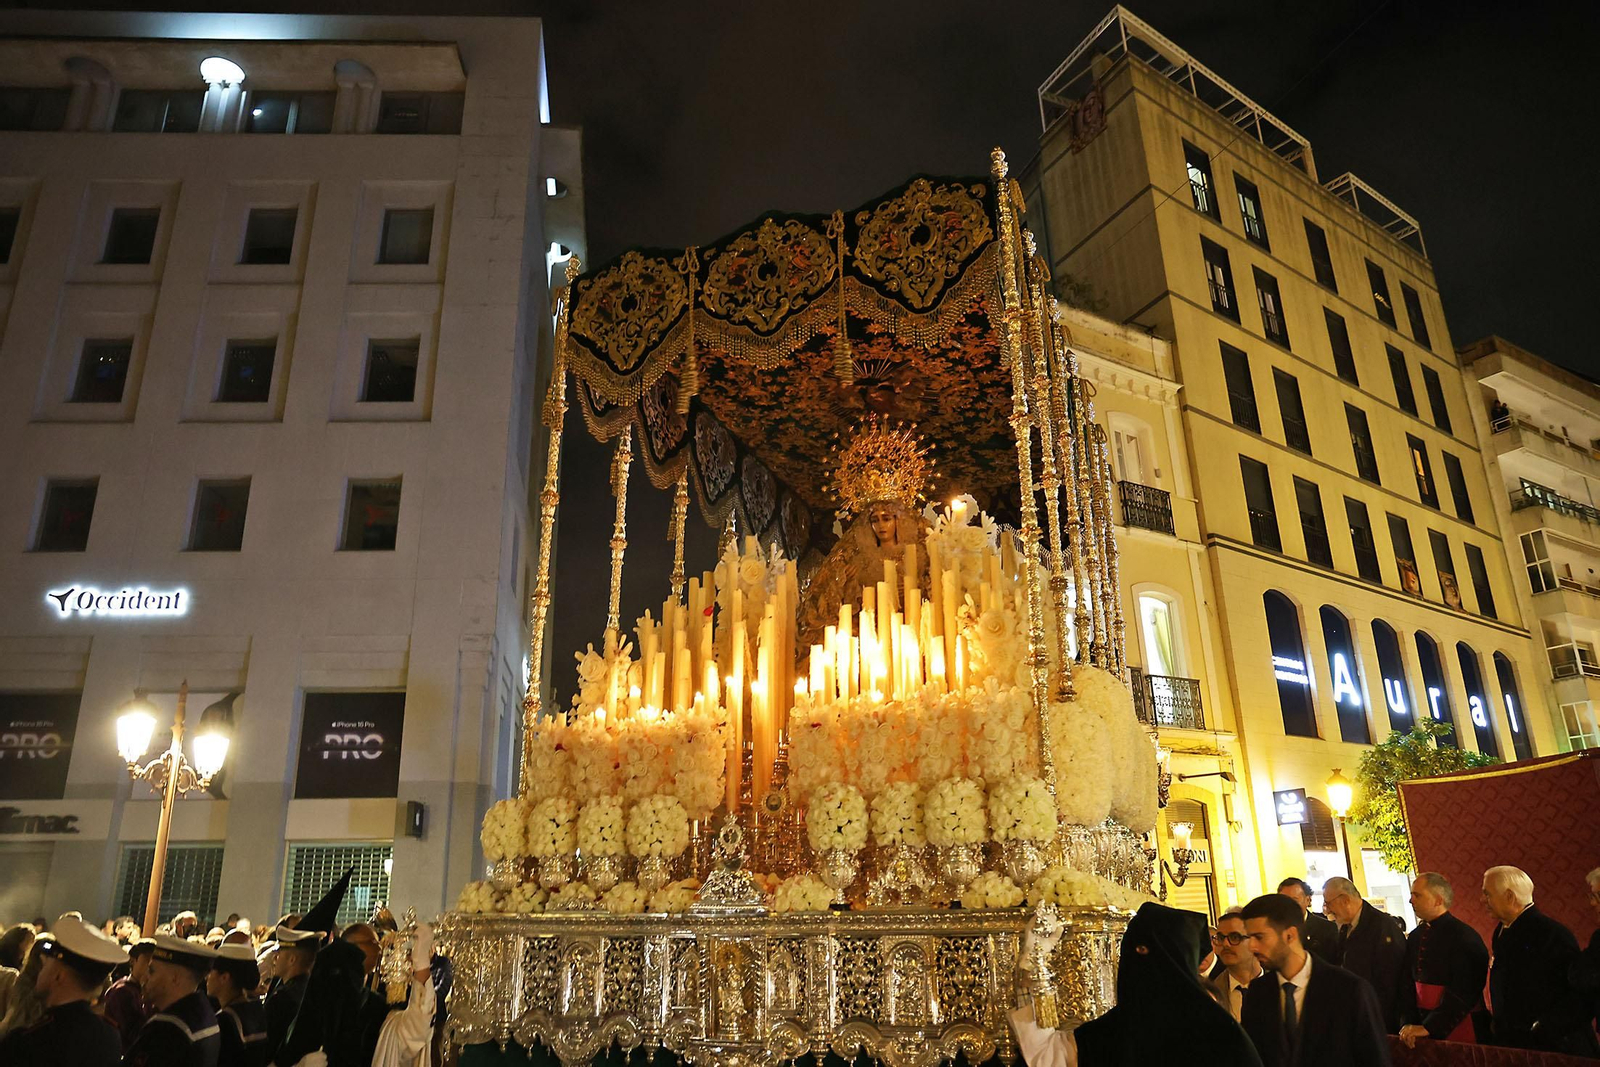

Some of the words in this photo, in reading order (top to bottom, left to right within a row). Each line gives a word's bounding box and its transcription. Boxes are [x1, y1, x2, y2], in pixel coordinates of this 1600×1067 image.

[76, 589, 182, 611] Occident
[1334, 652, 1519, 734] Aural
[0, 733, 62, 759] PRO
[323, 733, 384, 760] PRO
